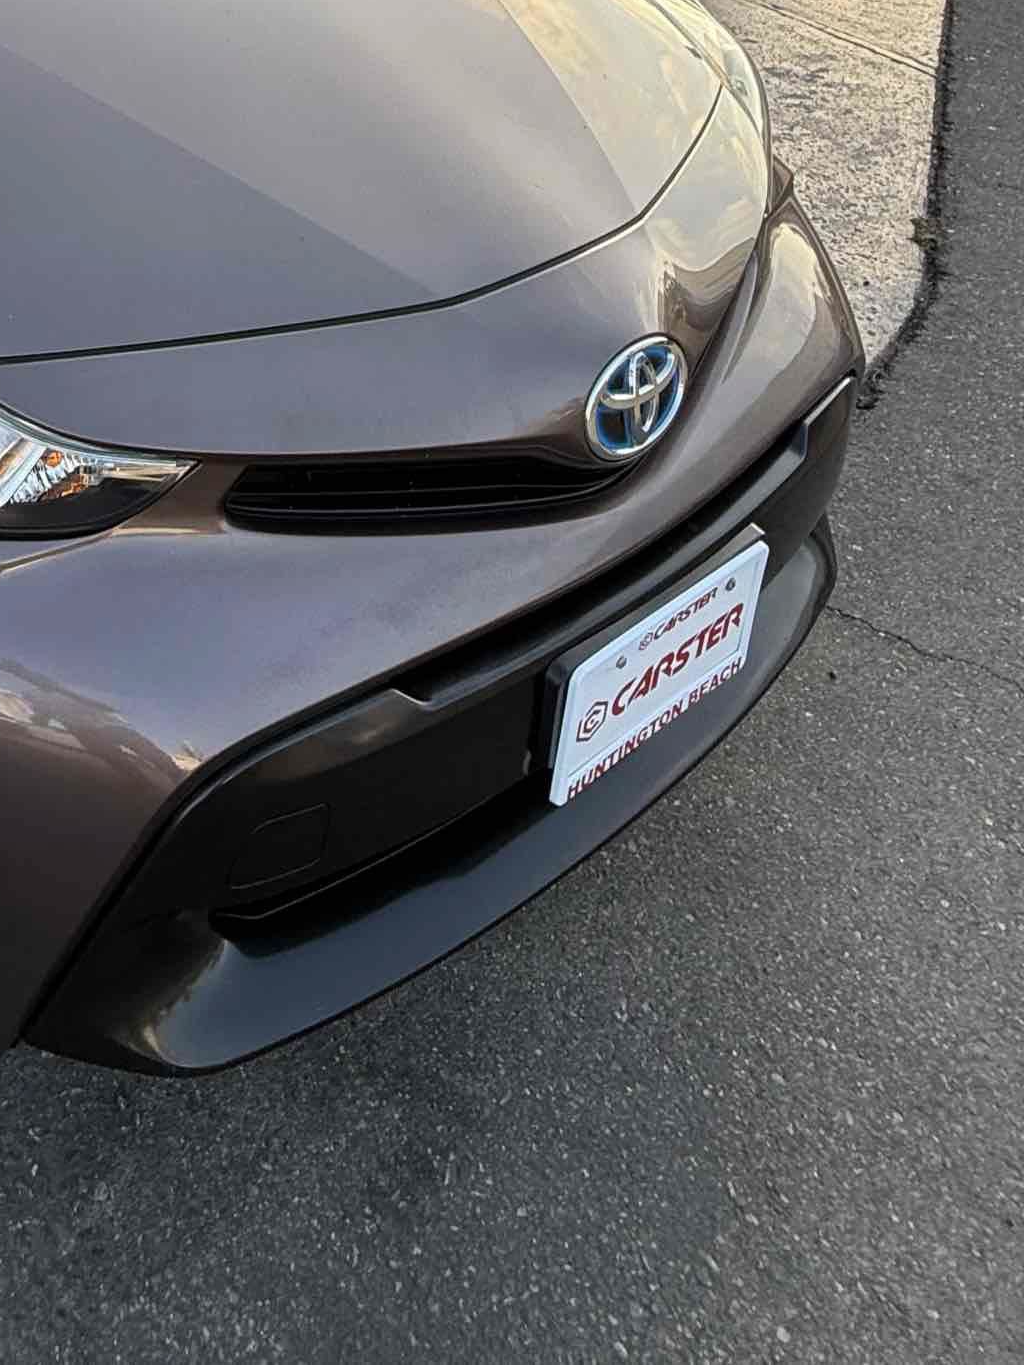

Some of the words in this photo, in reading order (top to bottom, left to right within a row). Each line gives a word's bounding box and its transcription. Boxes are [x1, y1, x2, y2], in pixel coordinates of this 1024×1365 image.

[611, 602, 744, 716] CARSTER
[568, 700, 683, 800] HUNTINGTON
[688, 656, 743, 705] BEACH
